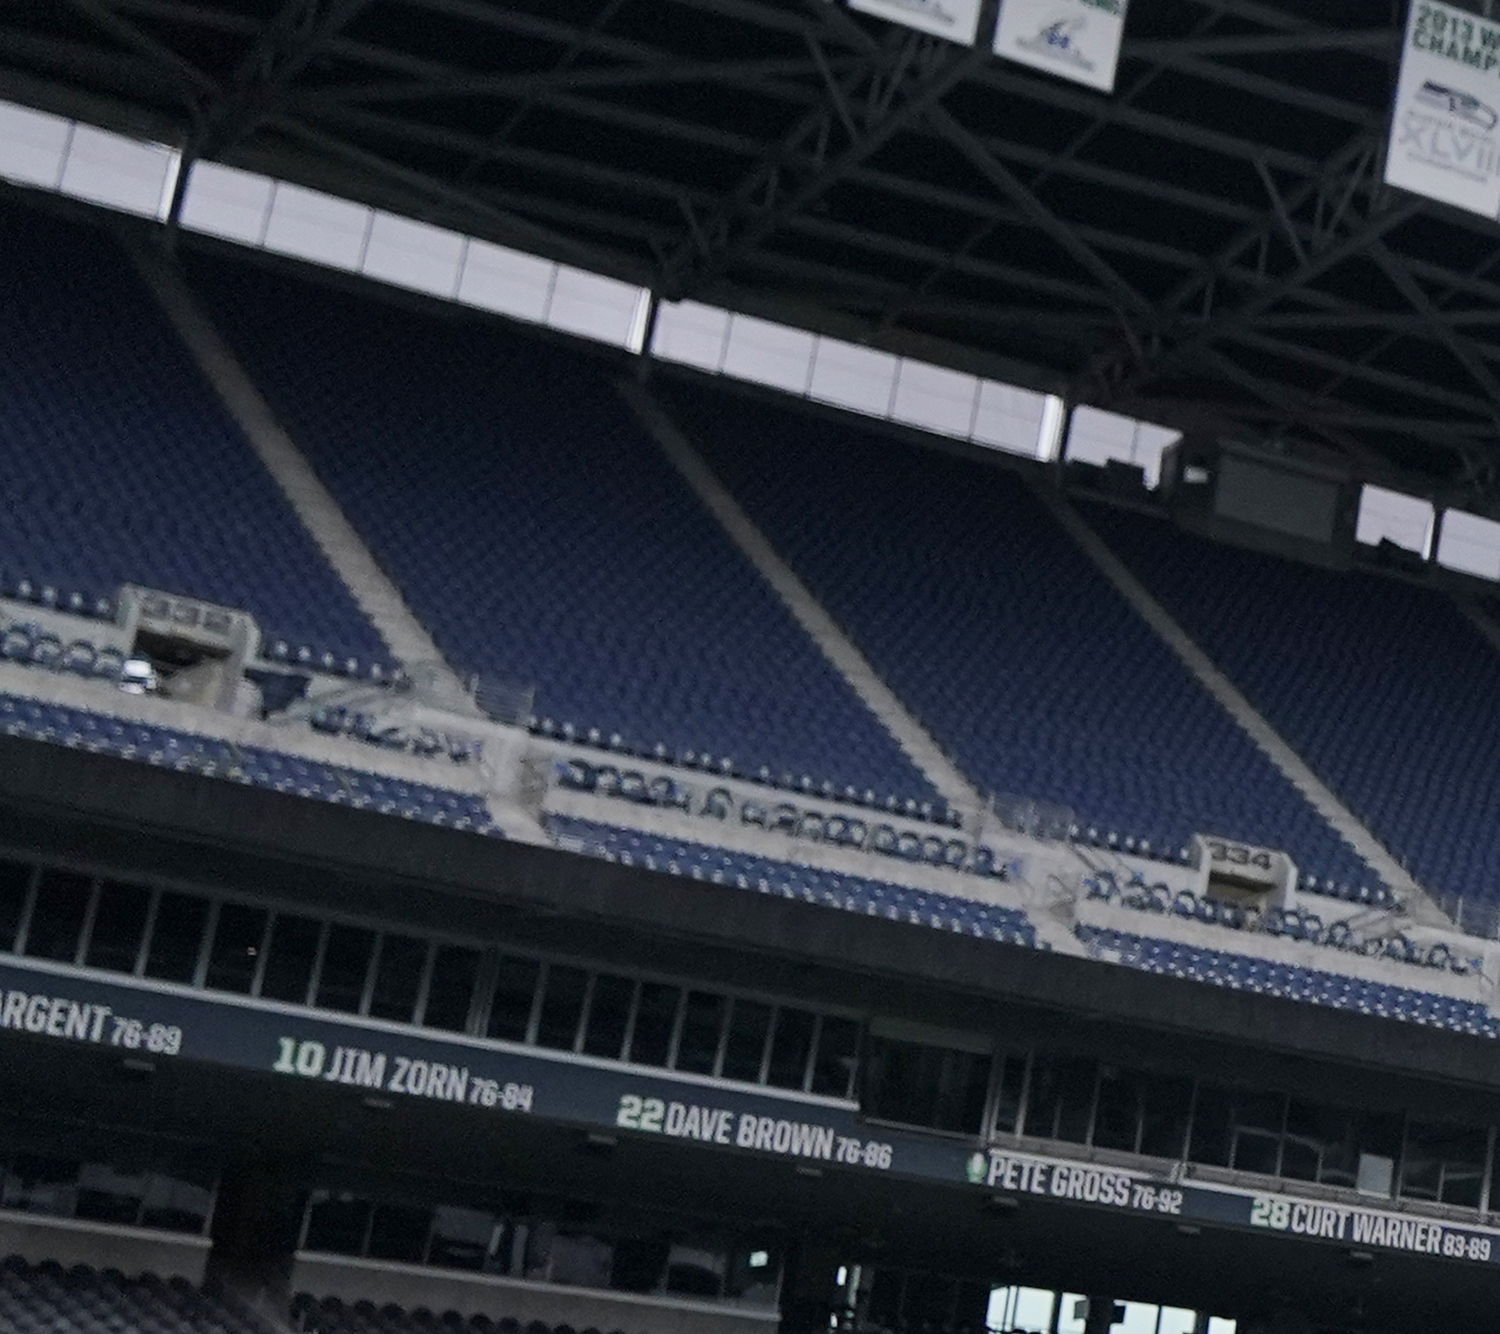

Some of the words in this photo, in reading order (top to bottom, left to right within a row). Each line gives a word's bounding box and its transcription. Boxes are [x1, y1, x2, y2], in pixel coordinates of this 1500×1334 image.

[1415, 4, 1475, 42] 2013
[0, 989, 113, 1044] RGENT
[110, 1016, 183, 1055] 76-89
[272, 1035, 326, 1078] 10
[323, 1045, 384, 1089] JIM
[388, 1055, 469, 1104] ZORN
[468, 1076, 534, 1113] 76-84
[616, 1093, 665, 1133] 22
[663, 1101, 732, 1145] DAVE
[735, 1113, 835, 1161] BROWN
[834, 1136, 894, 1171] 76-86
[986, 1155, 1048, 1194] PETE
[1050, 1169, 1131, 1208] GROSS
[1131, 1183, 1184, 1215] 76-92
[1250, 1195, 1290, 1230] 28
[1290, 1202, 1349, 1240] CURT
[1352, 1213, 1443, 1254] WARNER
[1441, 1231, 1492, 1262] 83-89
